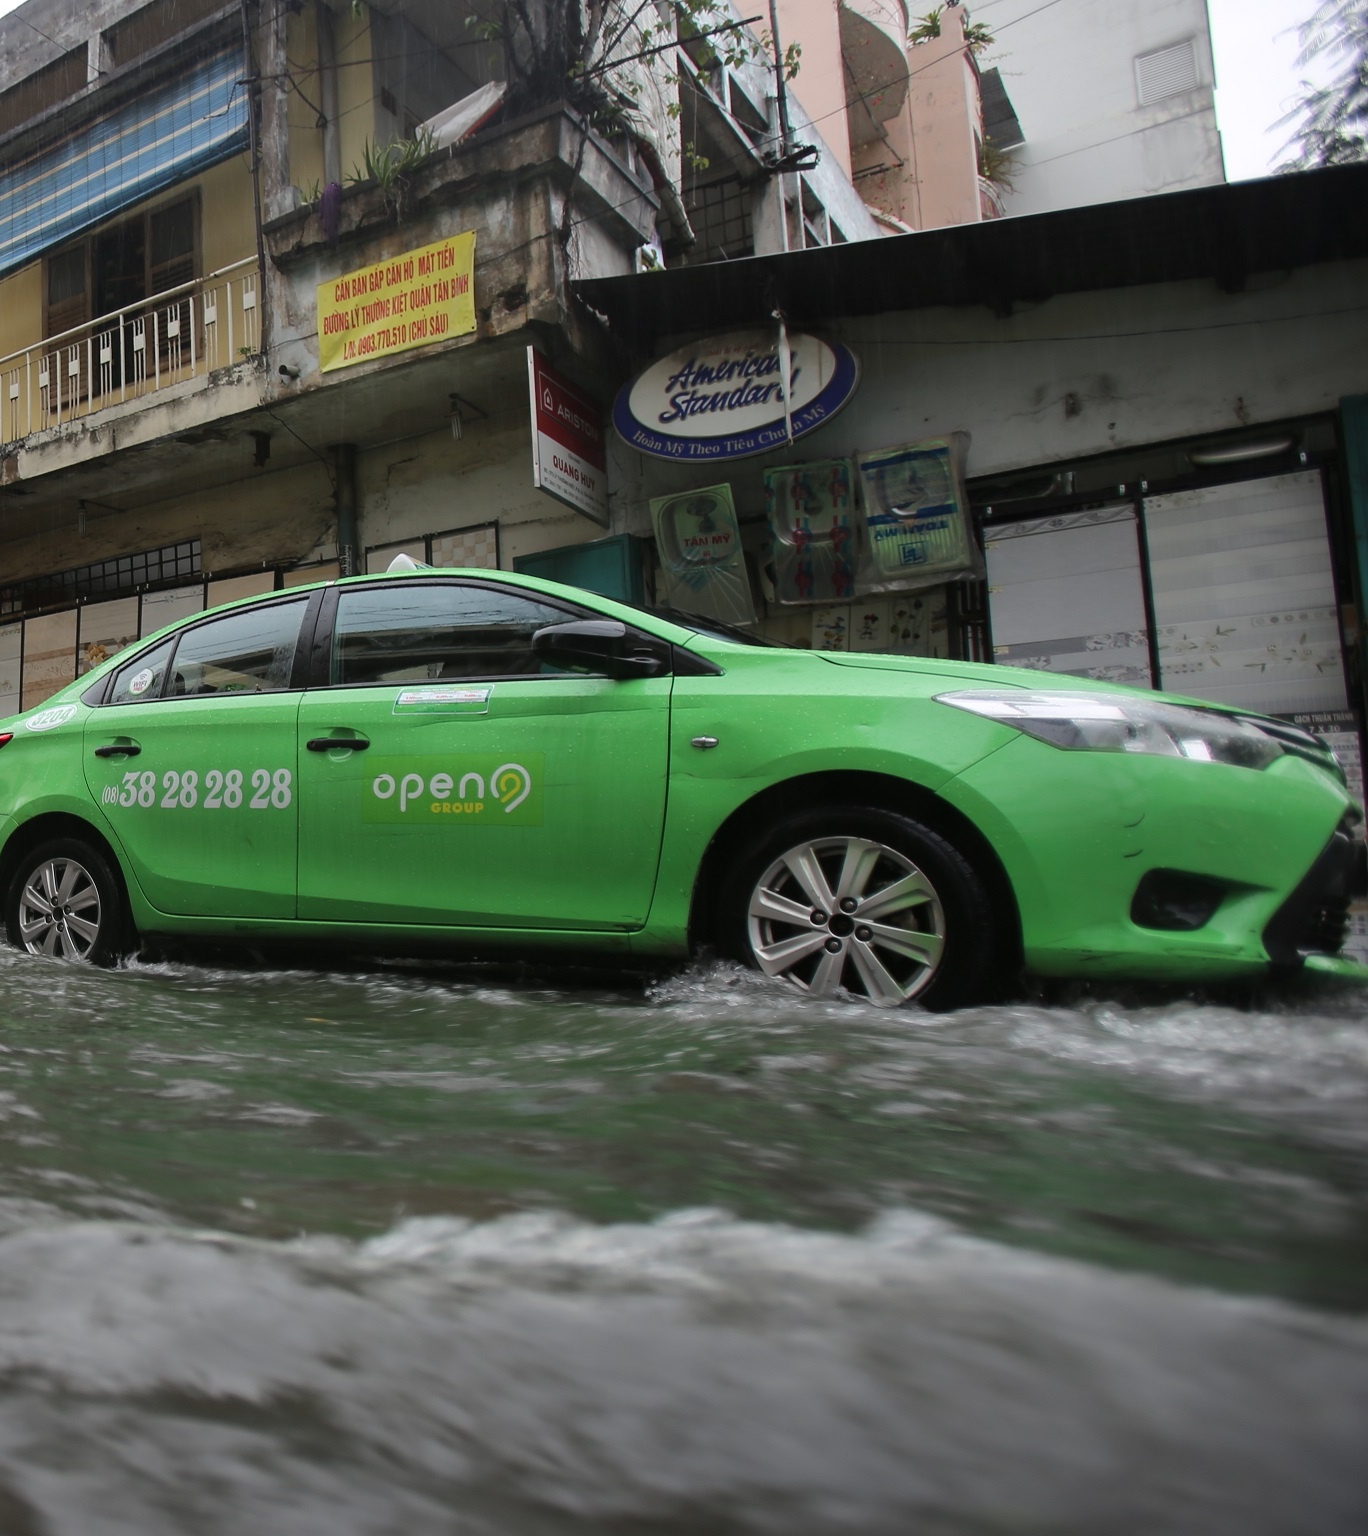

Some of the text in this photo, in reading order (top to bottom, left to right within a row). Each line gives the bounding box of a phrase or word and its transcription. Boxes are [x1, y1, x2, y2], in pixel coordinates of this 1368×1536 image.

[352, 273, 367, 298] BÁN
[369, 264, 384, 292] GẤP
[386, 262, 402, 287] CĂN
[403, 256, 414, 283] HỘ
[418, 251, 436, 279] MẶT
[323, 272, 469, 336] ĐƯỜNG LÝ THƯỜNG KIỆT QUẬN TÂN BÌNH
[358, 324, 407, 357] 0903.770.510
[429, 311, 449, 337] SÁU)
[557, 403, 599, 442] ARISTON
[633, 404, 825, 456] Hoàn Mỹ Theo Tiêu Chun Mỹ
[552, 454, 580, 482] QUANG
[580, 469, 596, 492] HUY
[133, 680, 148, 688] WIFI
[32, 708, 72, 726] 3204
[160, 770, 199, 808] 28
[203, 769, 243, 808] 28
[249, 768, 292, 809] 28
[431, 802, 485, 814] GROUP
